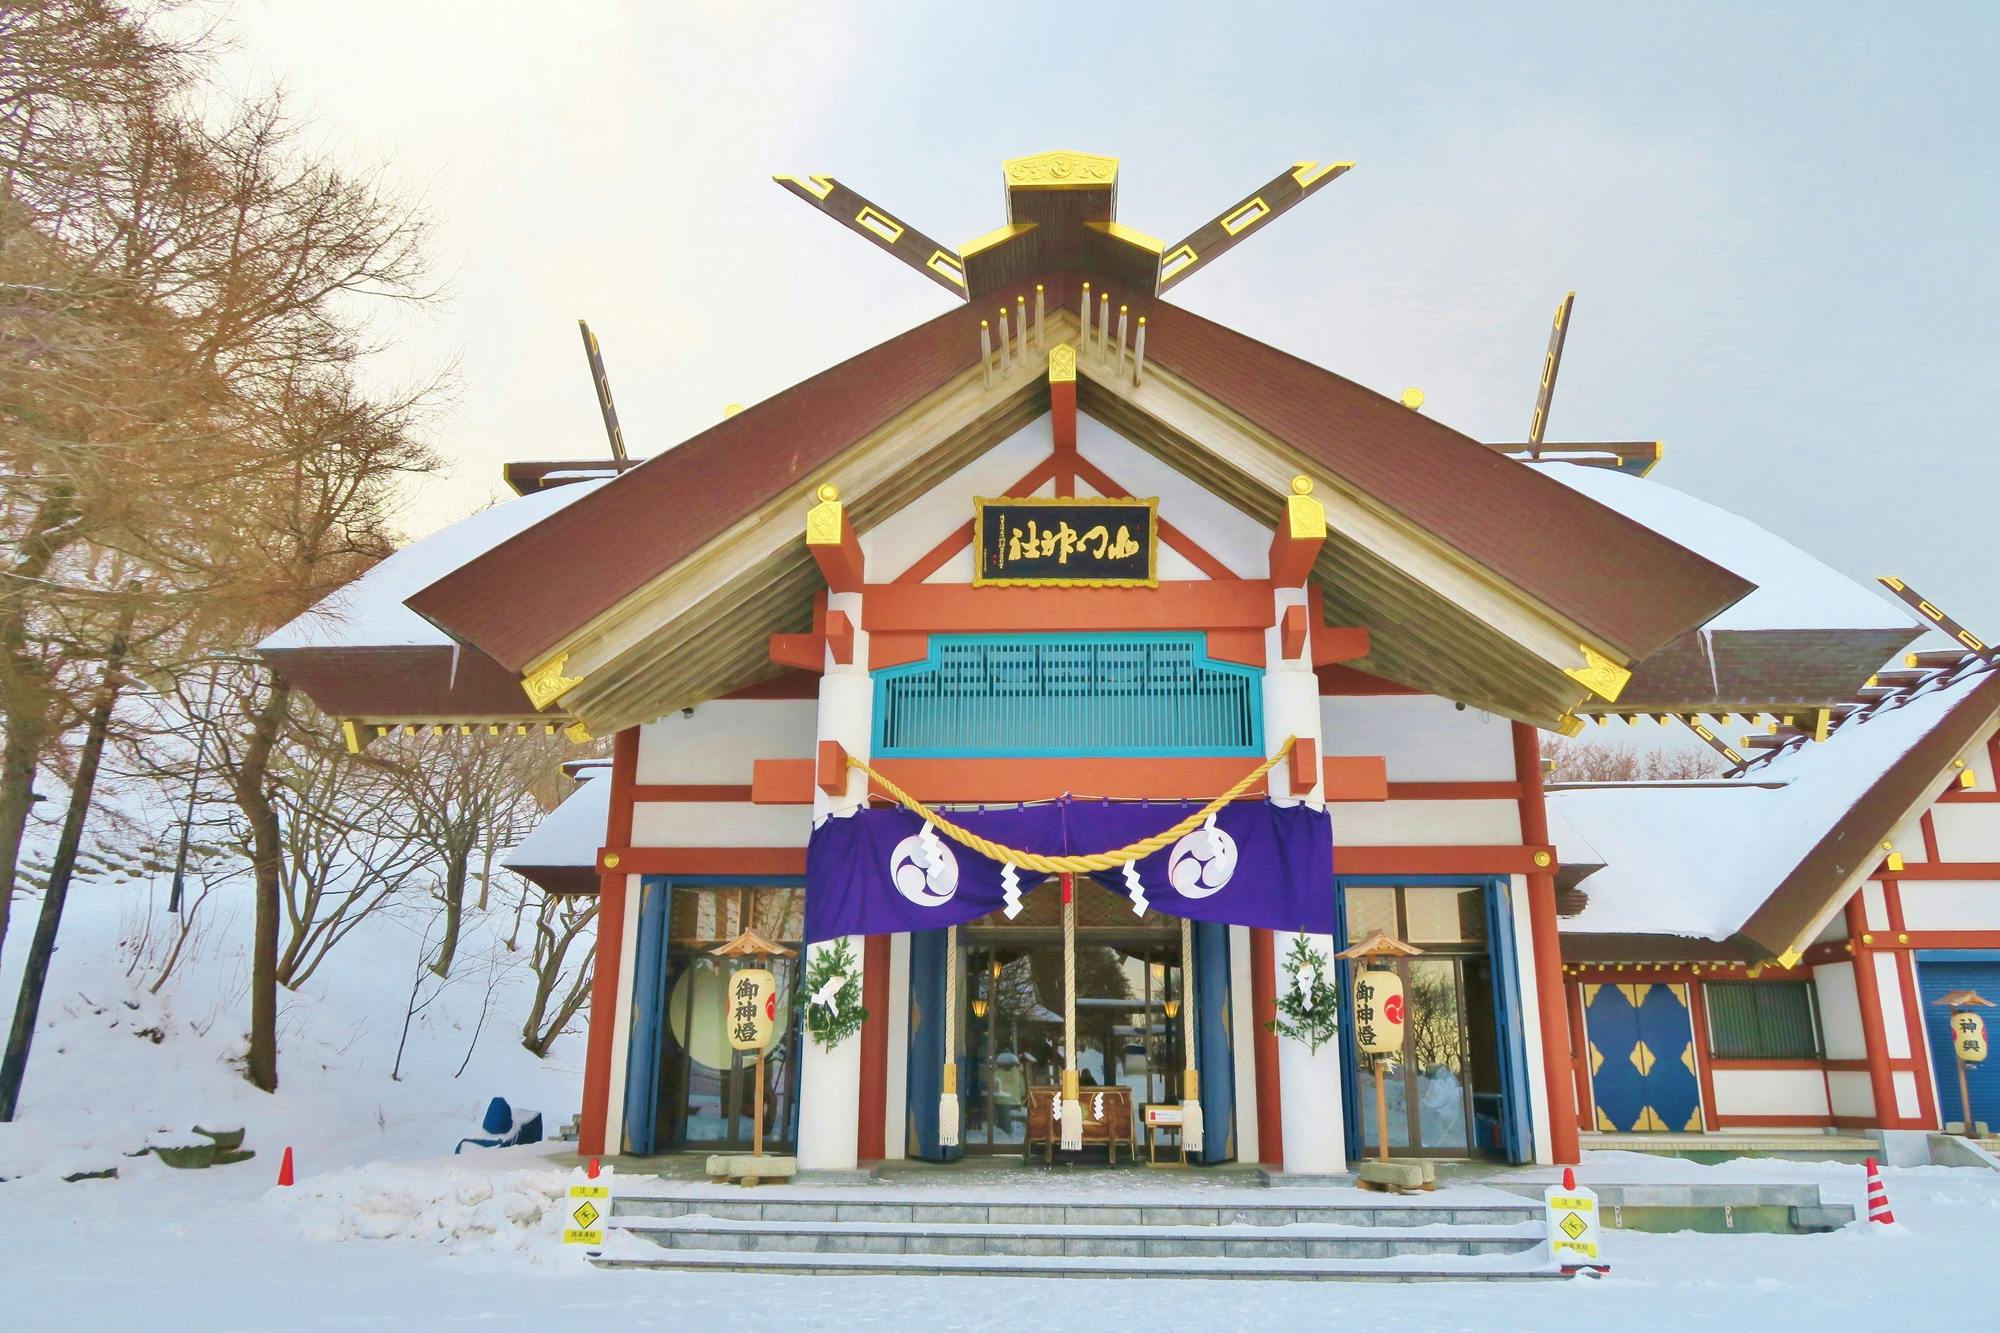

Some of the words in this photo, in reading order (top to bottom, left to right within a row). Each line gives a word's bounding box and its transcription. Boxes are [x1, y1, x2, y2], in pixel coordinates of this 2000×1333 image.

[734, 977, 760, 1042] 御神燈
[1355, 980, 1377, 1046] 御神燈
